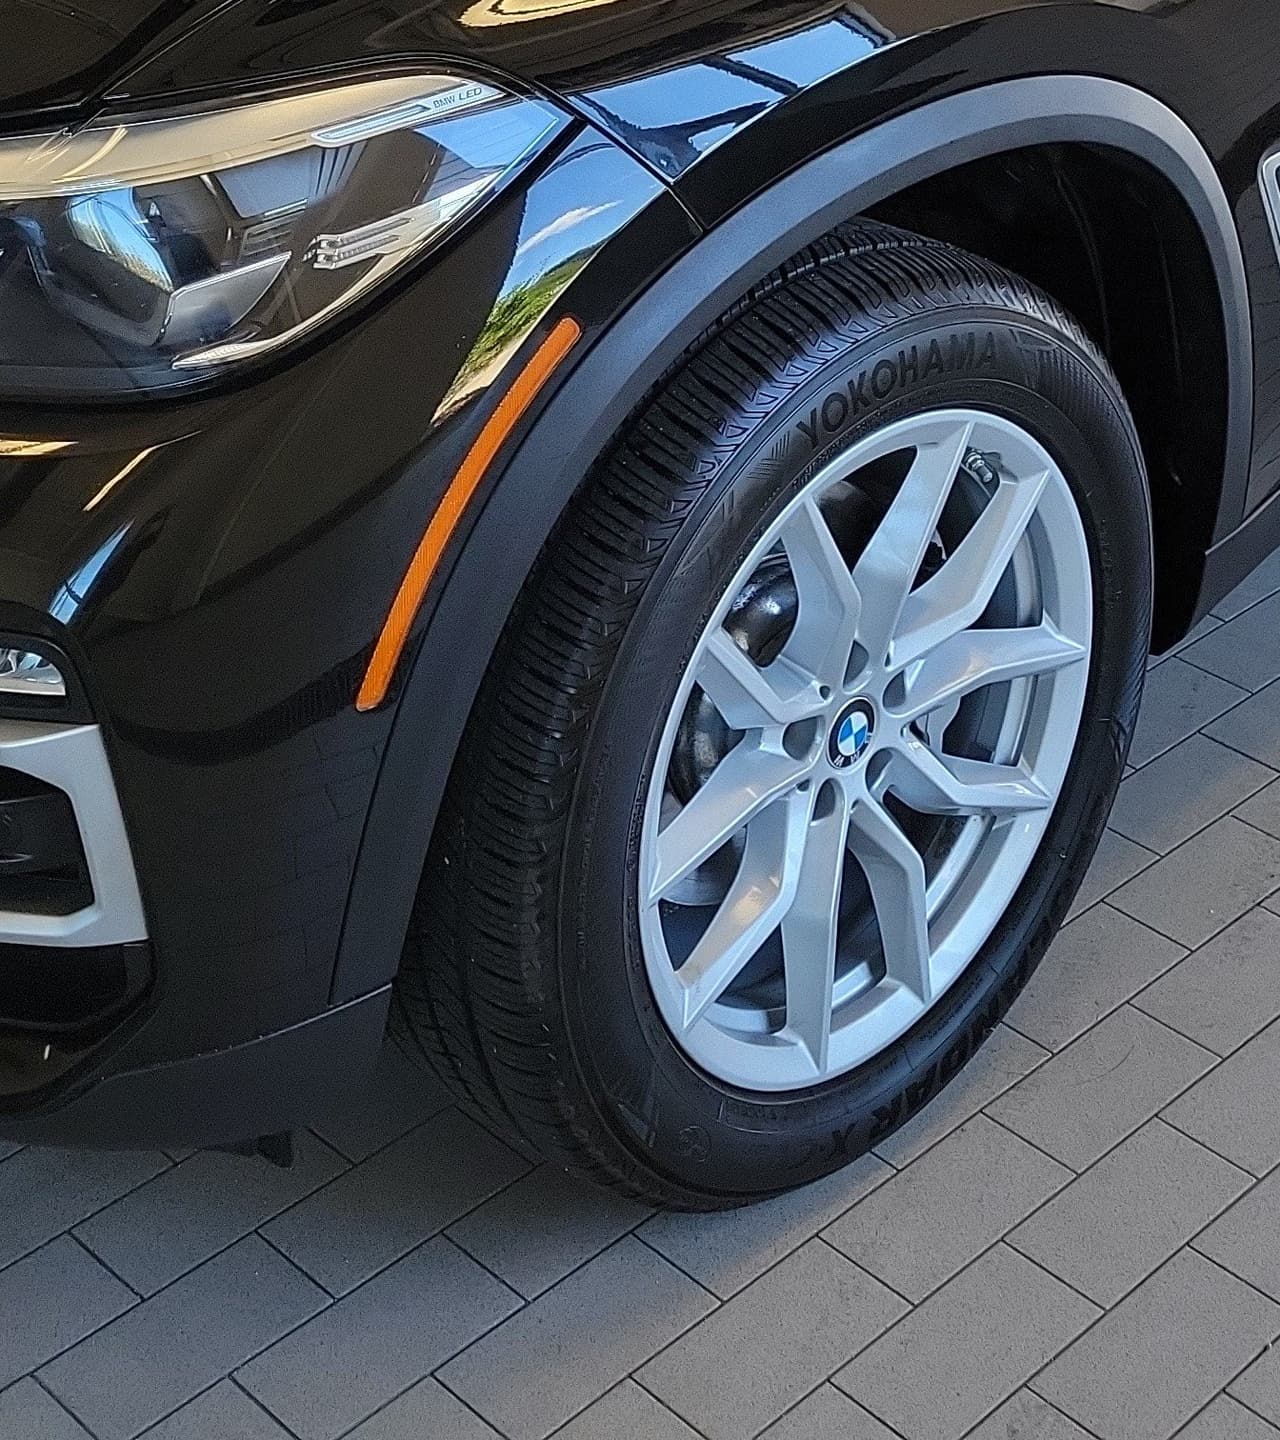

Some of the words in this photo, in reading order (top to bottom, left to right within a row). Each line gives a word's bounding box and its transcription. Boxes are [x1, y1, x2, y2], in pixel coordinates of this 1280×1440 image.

[432, 95, 455, 108] BMW
[459, 87, 482, 100] LED
[796, 331, 998, 449] YOKOHAMA
